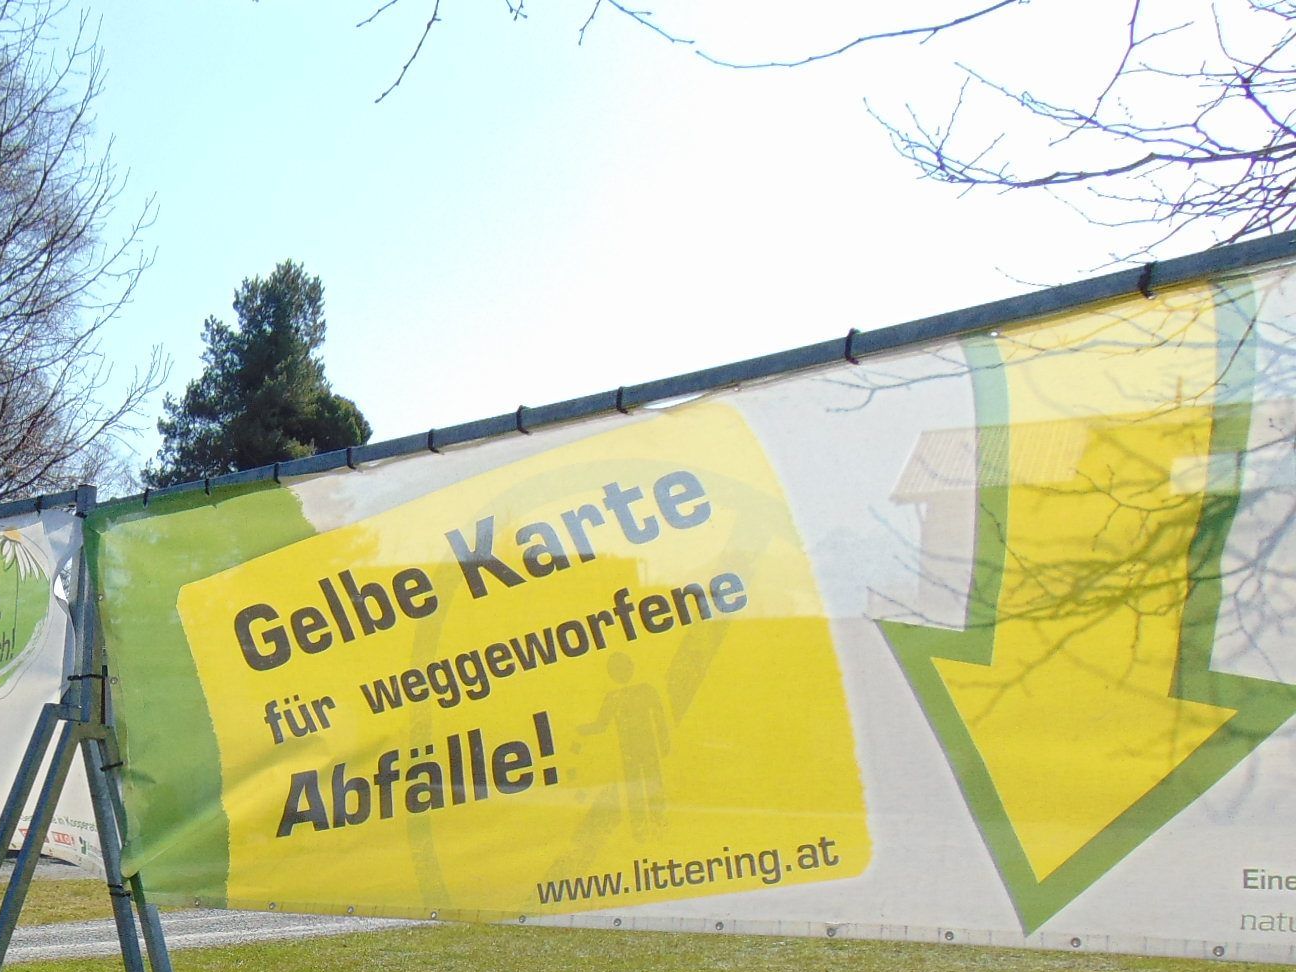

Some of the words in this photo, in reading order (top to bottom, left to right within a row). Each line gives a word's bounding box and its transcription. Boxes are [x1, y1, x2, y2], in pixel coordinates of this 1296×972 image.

[233, 567, 439, 672] Gelbe
[445, 468, 712, 602] Karte
[264, 692, 336, 744] für
[360, 571, 748, 715] weggeworfene
[275, 710, 560, 838] Abfälle!
[536, 835, 841, 904] www.littering.at
[1243, 869, 1296, 890] Eine
